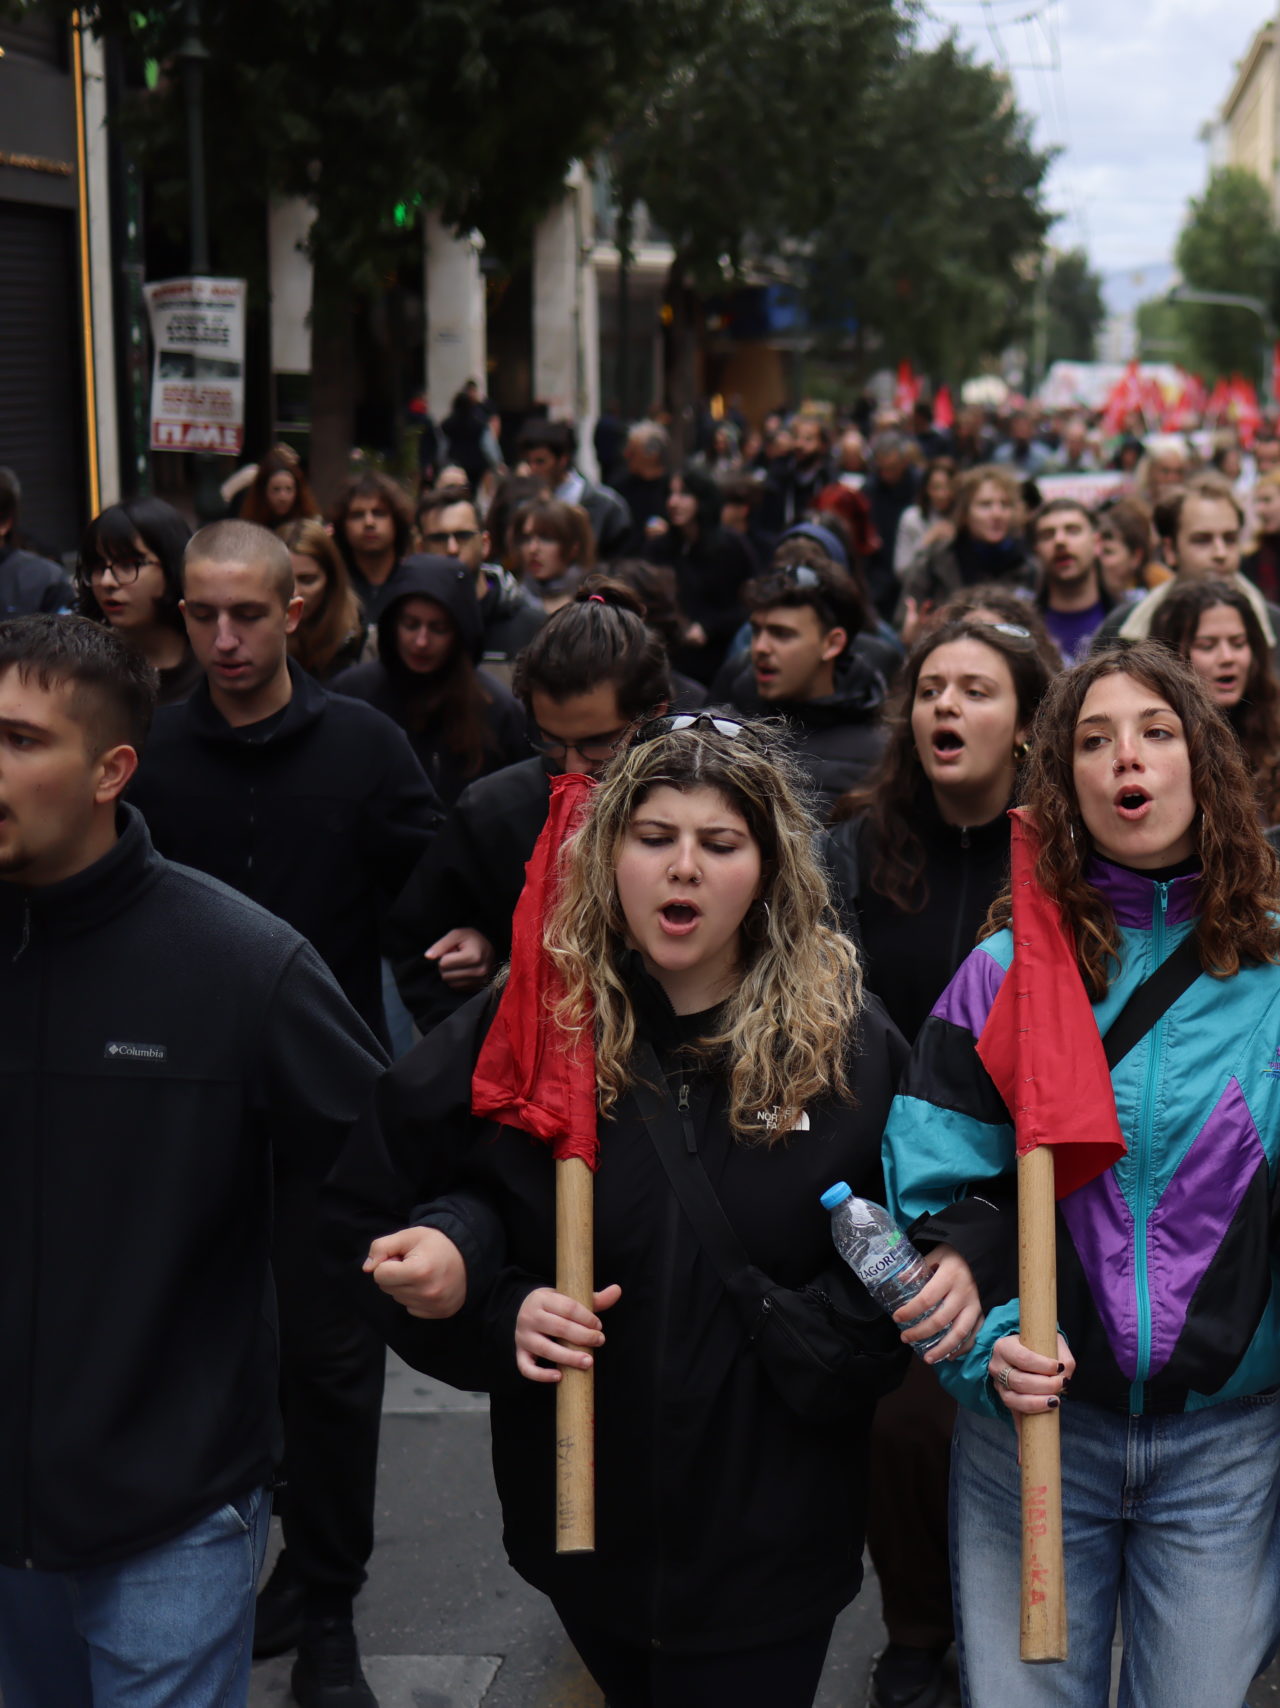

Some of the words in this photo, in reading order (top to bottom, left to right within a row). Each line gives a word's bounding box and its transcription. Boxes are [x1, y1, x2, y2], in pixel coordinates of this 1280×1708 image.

[118, 1045, 164, 1058] Columbia
[772, 1105, 791, 1116] TE
[857, 1252, 896, 1280] ZAGORI
